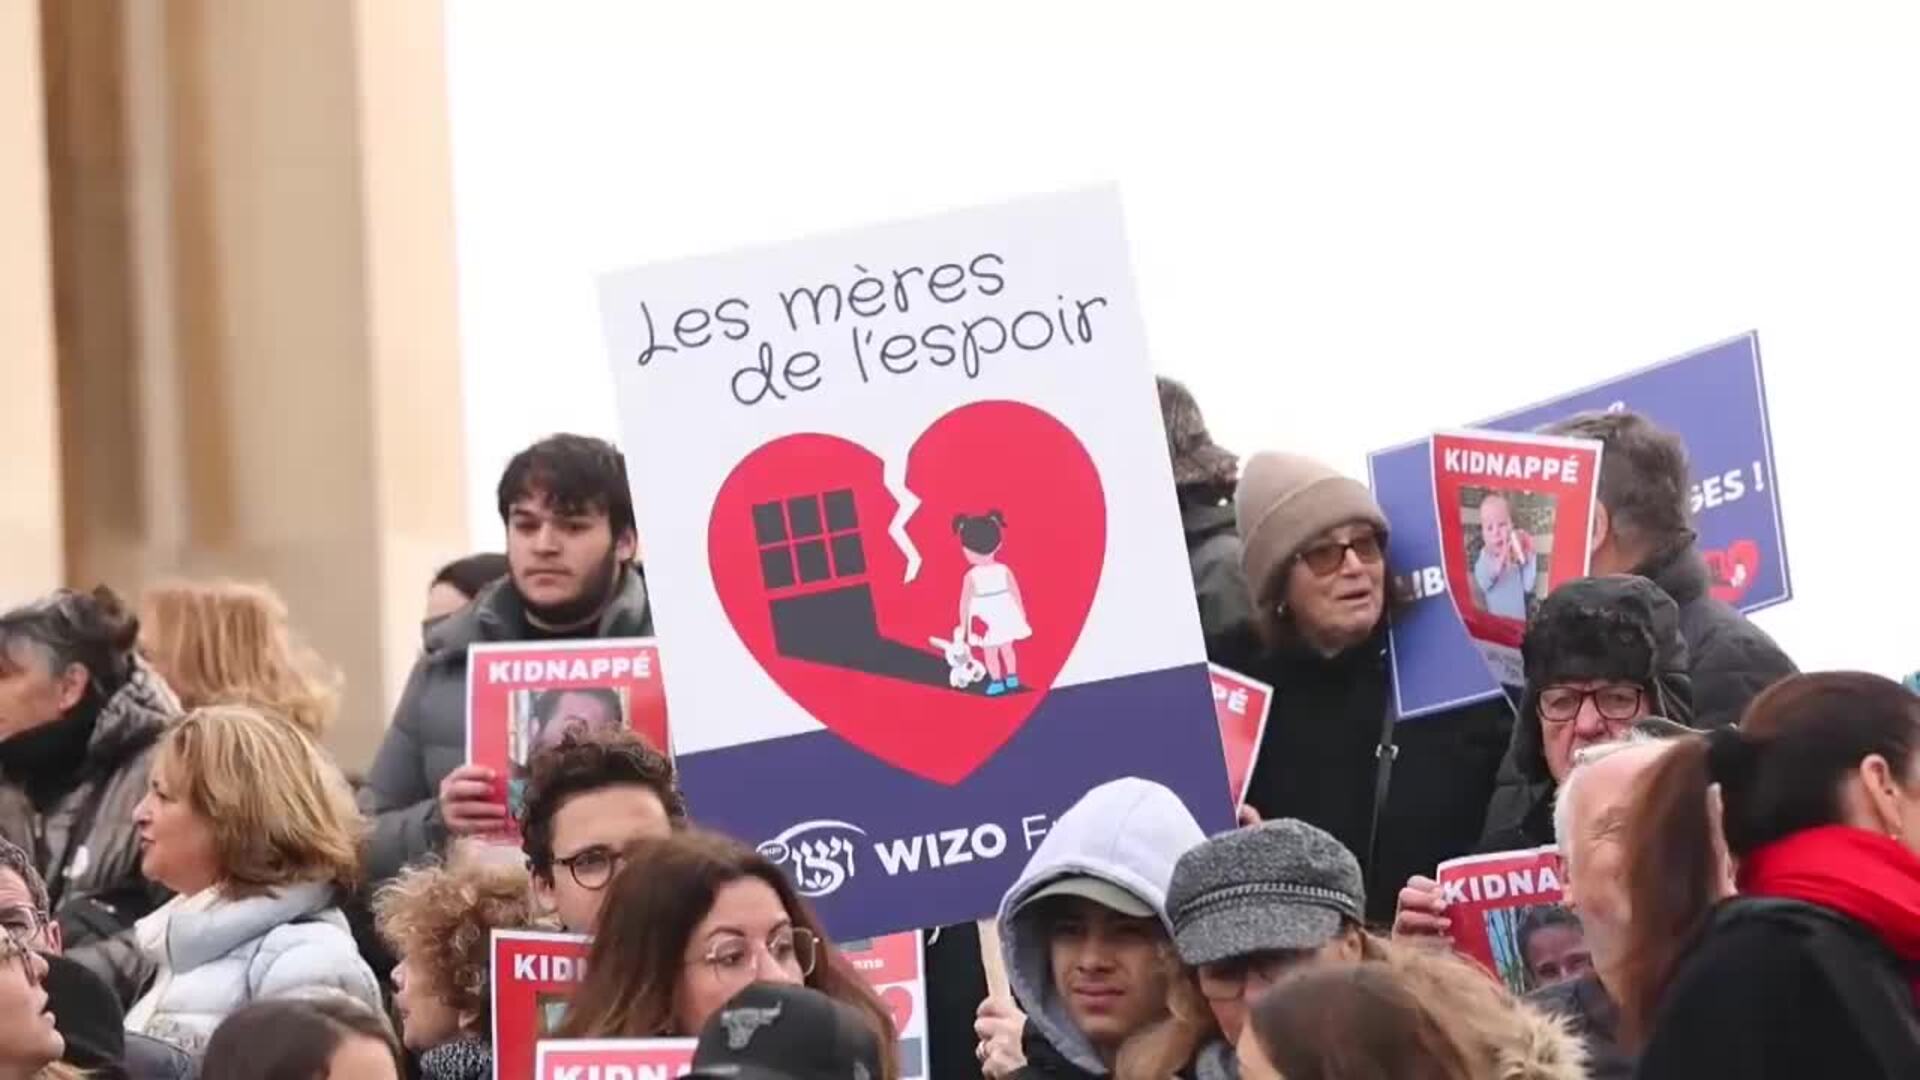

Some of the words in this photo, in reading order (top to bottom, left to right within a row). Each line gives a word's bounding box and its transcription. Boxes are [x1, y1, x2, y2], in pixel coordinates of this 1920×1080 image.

[638, 299, 749, 366] Les
[780, 253, 1005, 330] mères
[731, 342, 822, 405] de
[853, 294, 1107, 382] l'espoir
[1444, 448, 1580, 485] KIDNAPPÉ
[488, 650, 650, 684] KIDNAPPÉ
[873, 822, 1007, 876] WIZO
[1021, 814, 1058, 850] F
